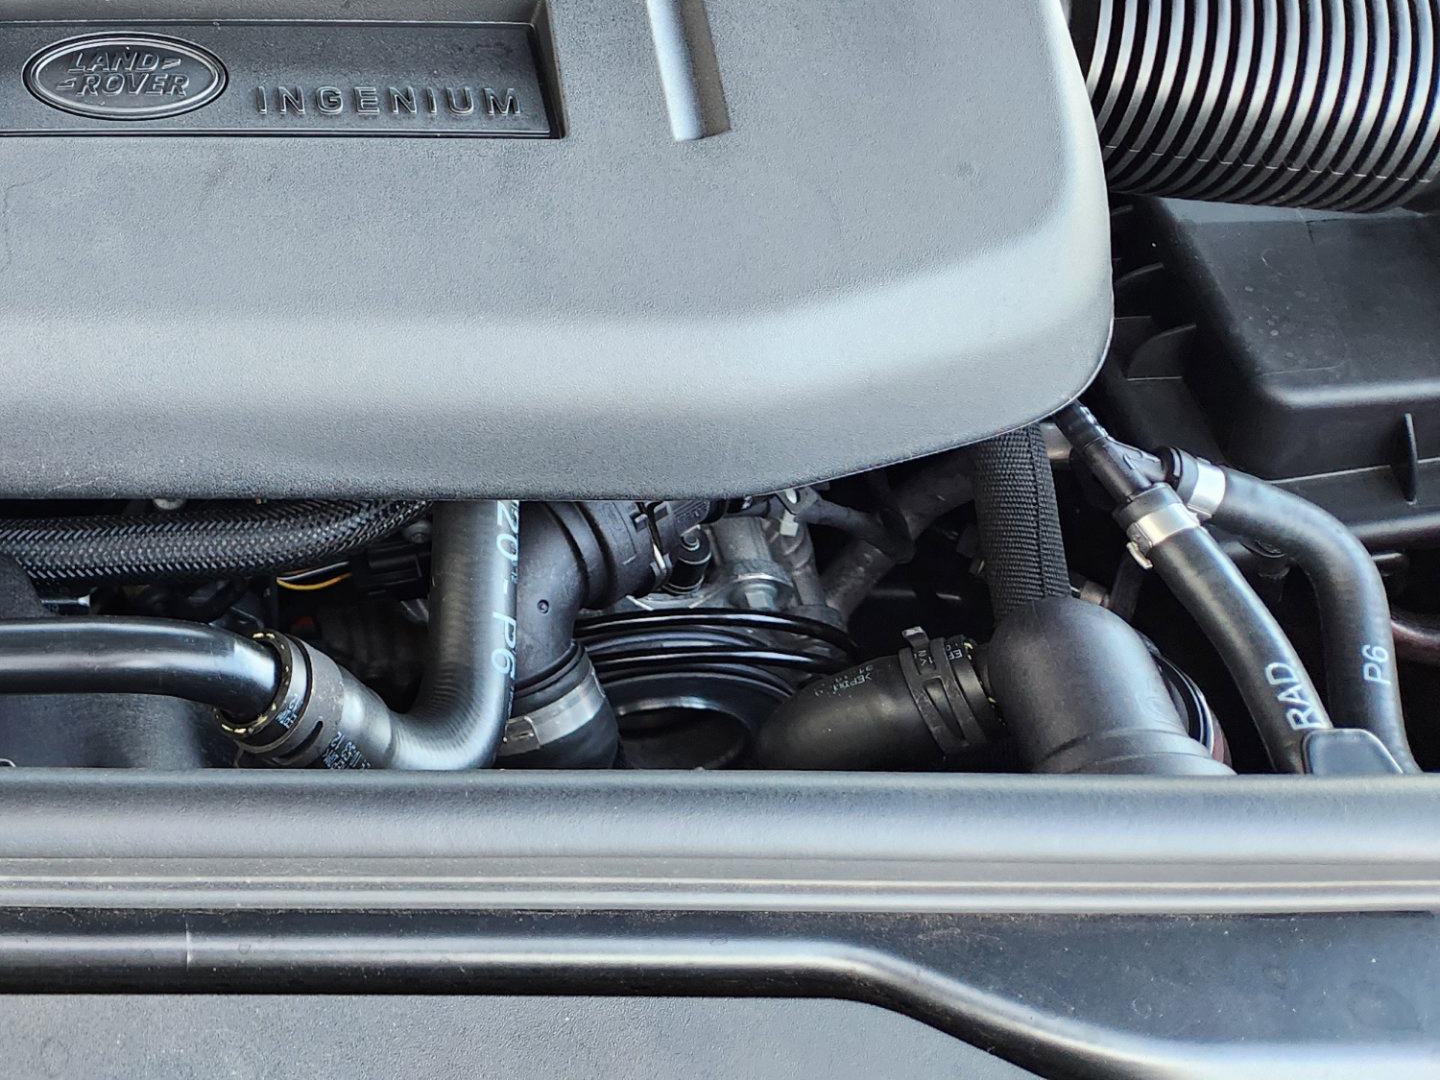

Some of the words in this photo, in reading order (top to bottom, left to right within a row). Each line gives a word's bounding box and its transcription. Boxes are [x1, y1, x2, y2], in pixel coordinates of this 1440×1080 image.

[67, 46, 160, 73] LAND
[75, 72, 190, 97] ROVER
[255, 85, 522, 116] INGENIUM
[491, 611, 517, 680] P6
[1361, 644, 1392, 686] P6
[1265, 661, 1327, 731] RAD
